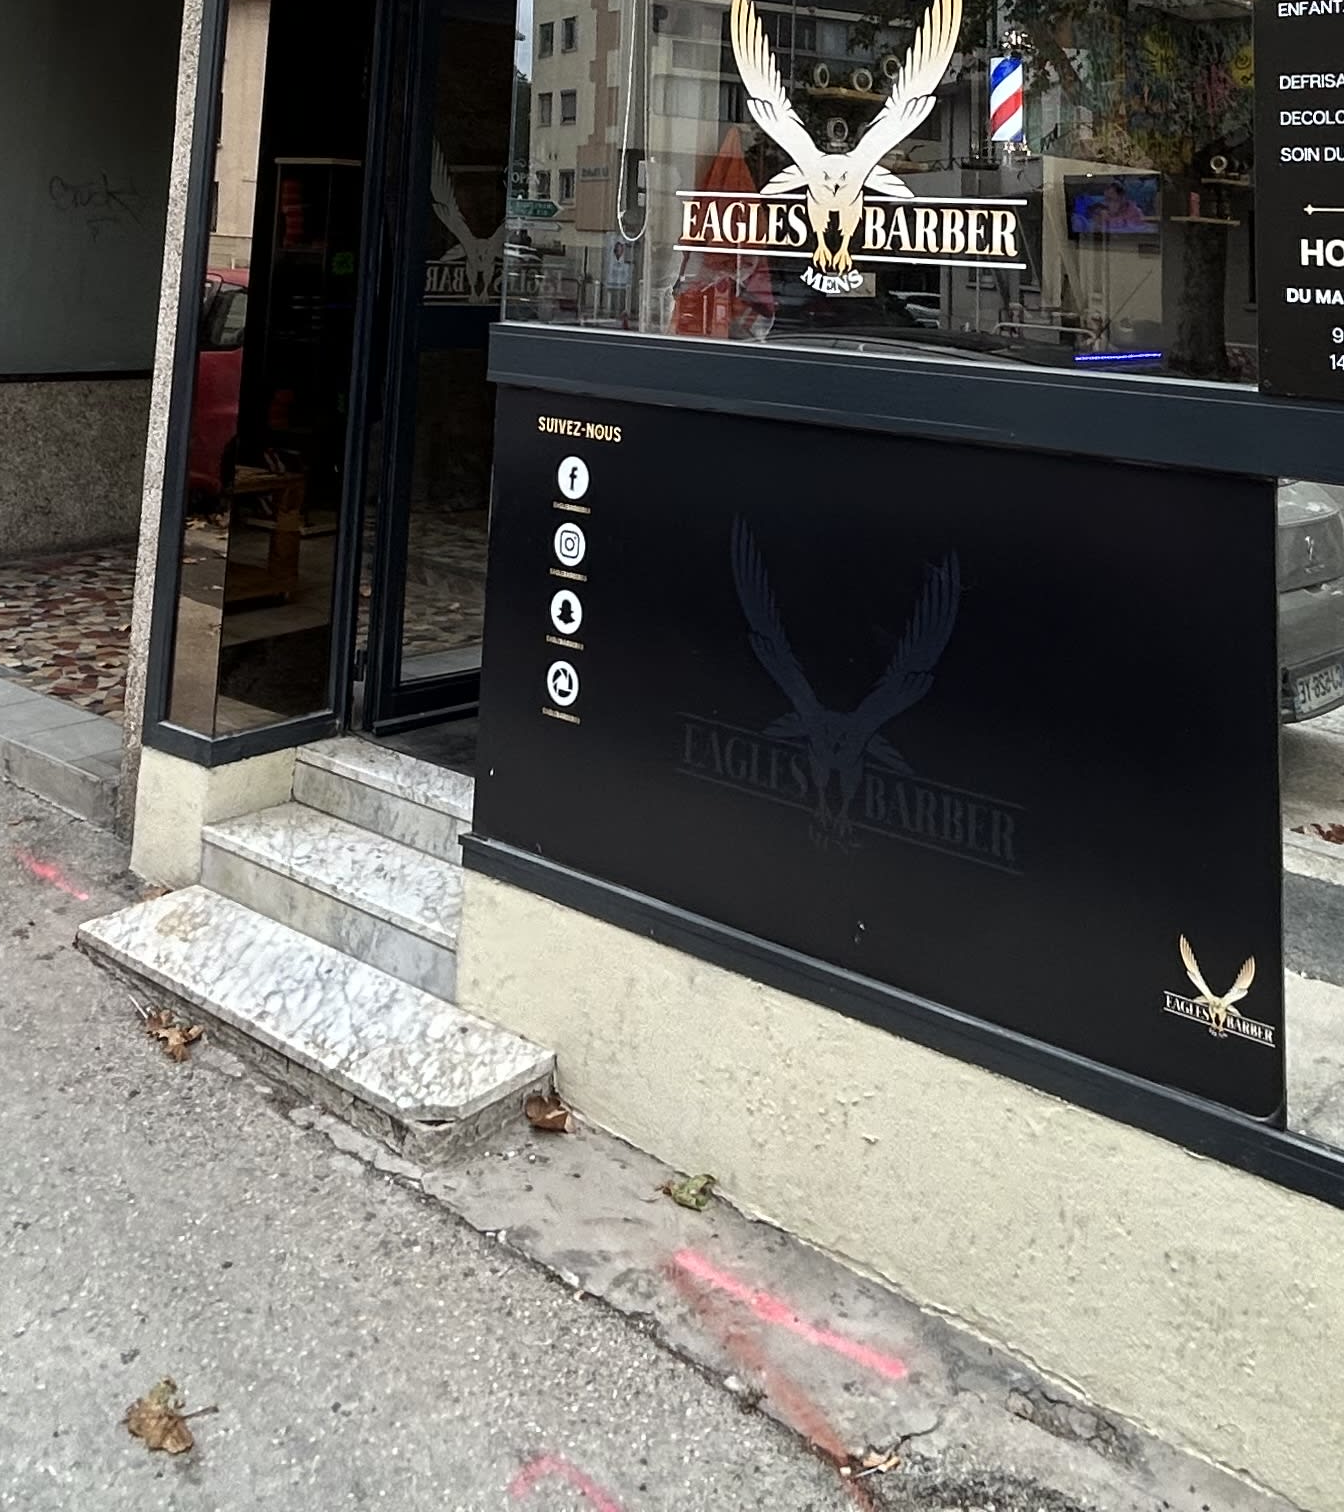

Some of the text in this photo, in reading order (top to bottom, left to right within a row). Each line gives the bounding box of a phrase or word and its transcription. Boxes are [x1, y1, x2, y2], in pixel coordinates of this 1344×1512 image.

[1280, 147, 1320, 163] SOIN
[679, 199, 1019, 258] EAGLES BARBER
[799, 266, 864, 294] MENS
[1286, 287, 1312, 304] DU
[537, 415, 622, 442] SUIVEZ-NOUS
[681, 722, 1017, 862] EAGLES BARBER
[1165, 994, 1274, 1044] EAGLES BARBER
